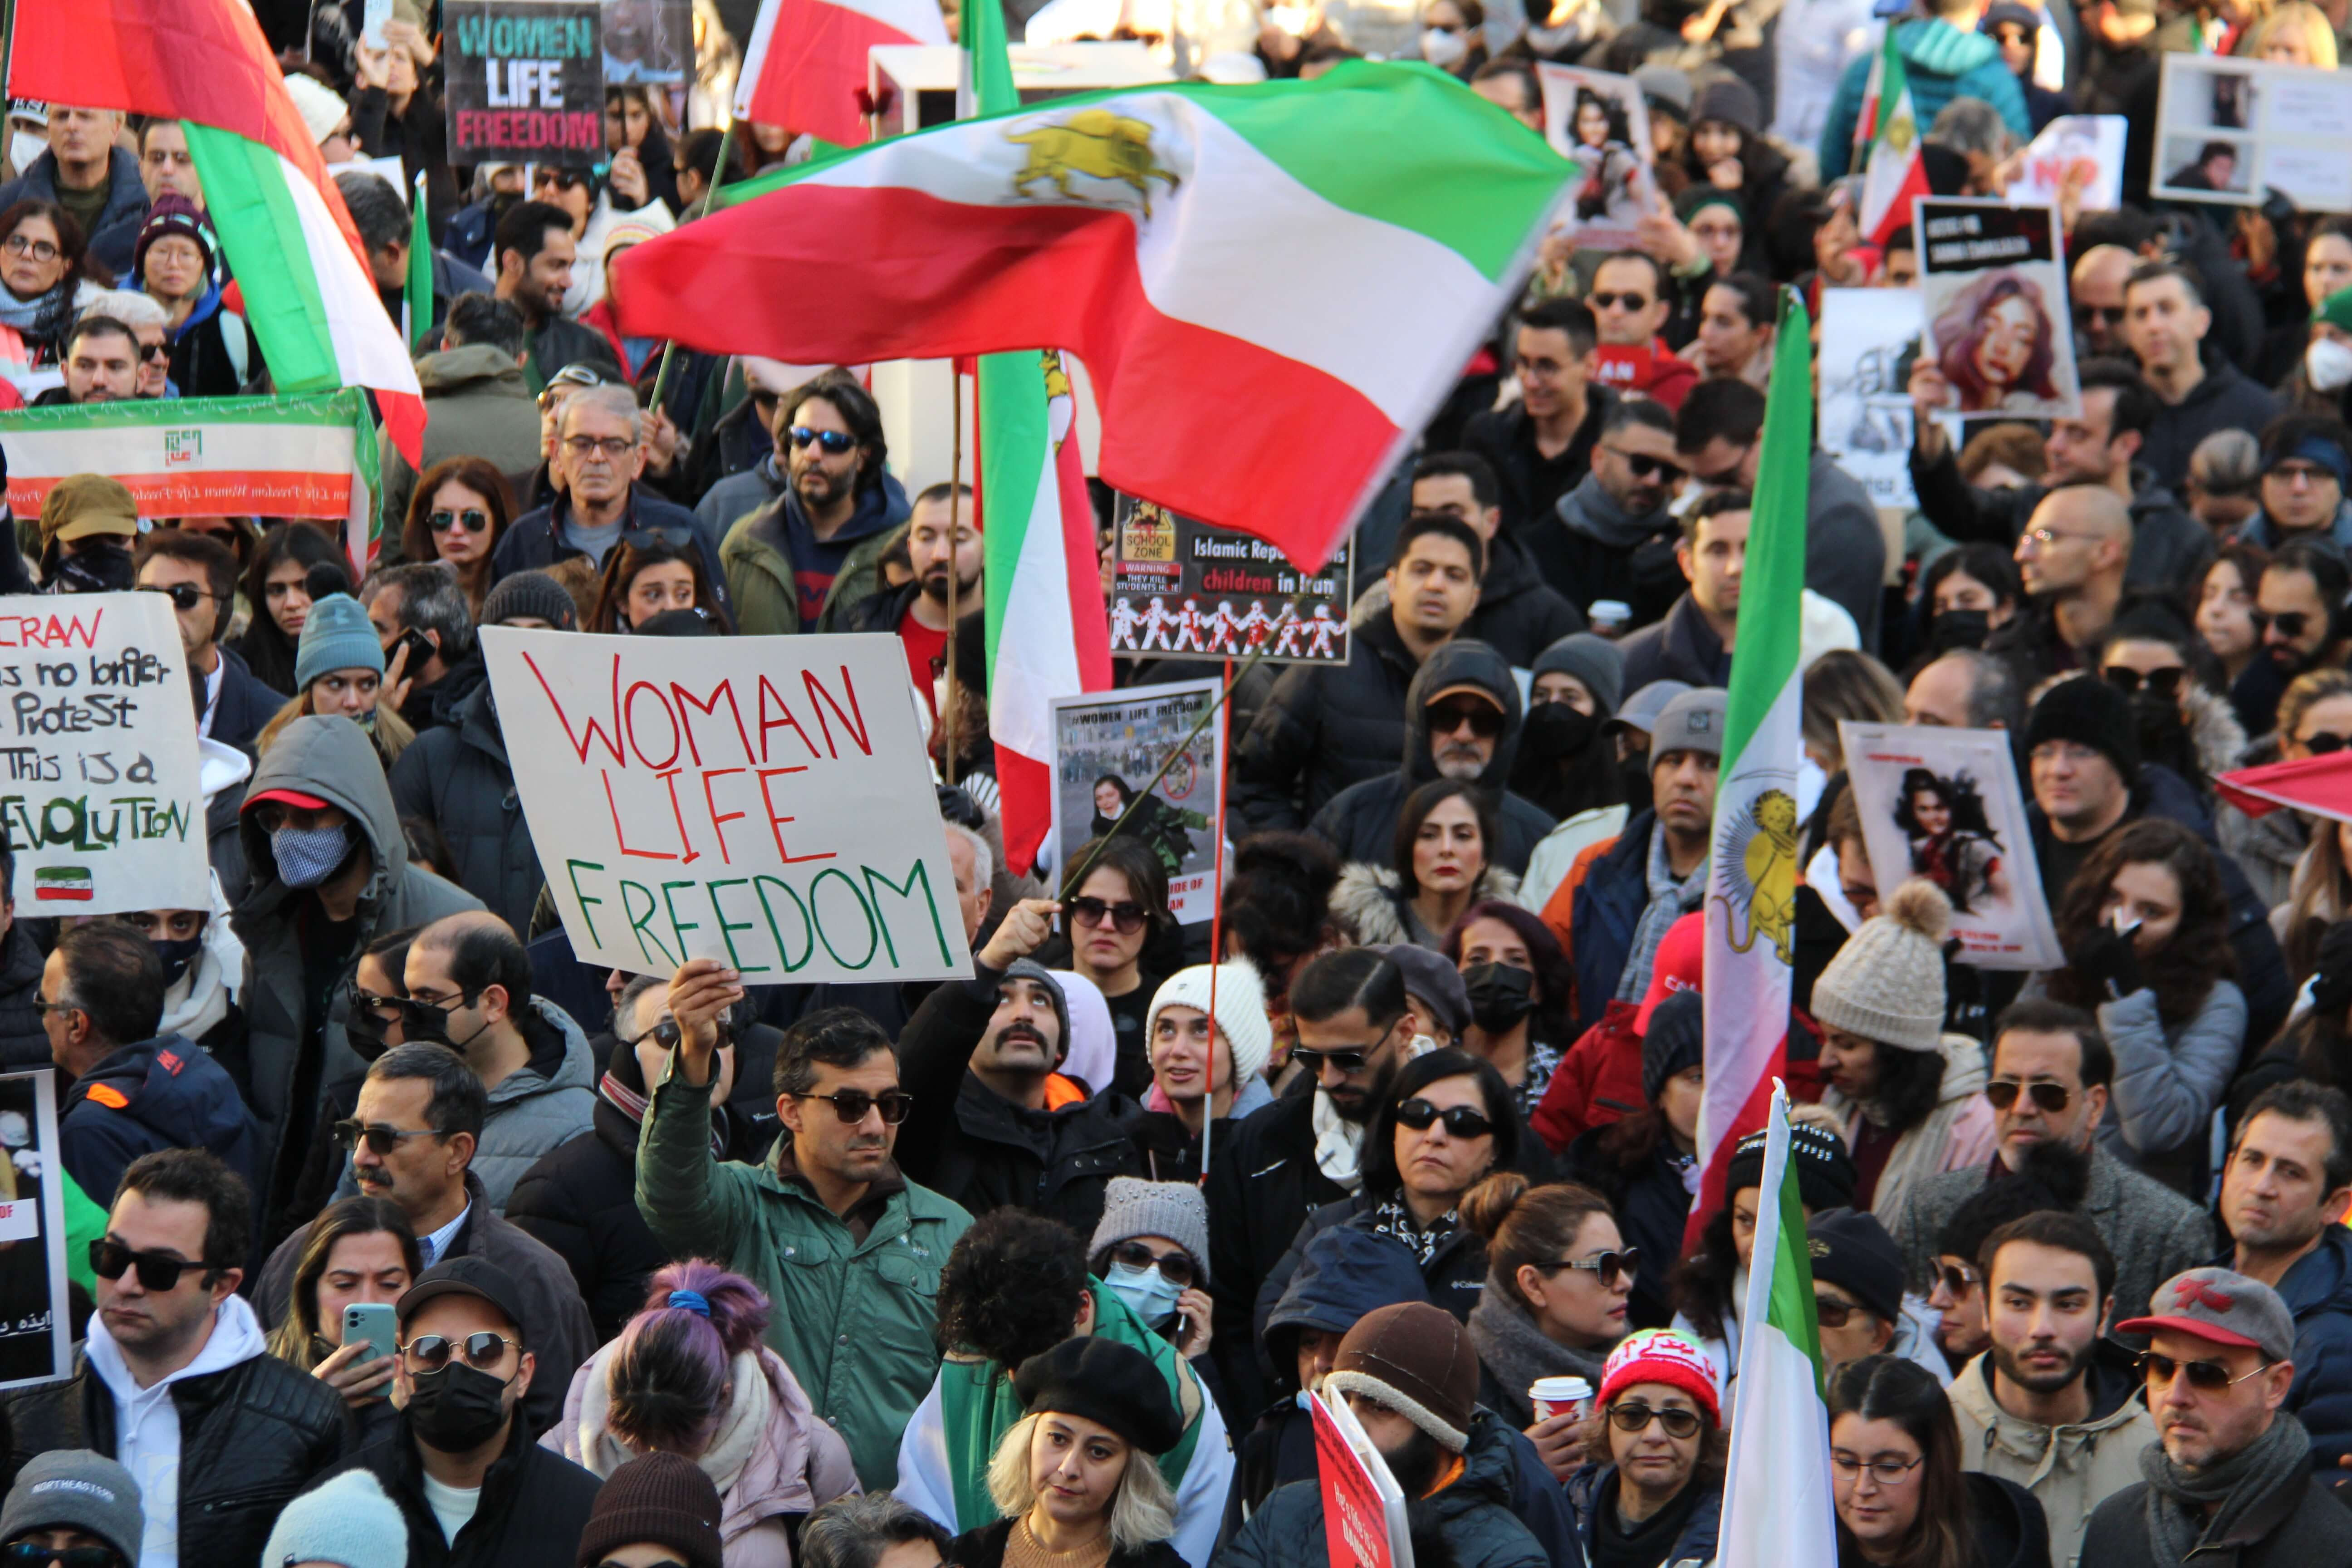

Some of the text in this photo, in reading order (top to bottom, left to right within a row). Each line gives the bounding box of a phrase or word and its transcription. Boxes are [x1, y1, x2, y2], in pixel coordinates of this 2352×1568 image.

[457, 16, 592, 59] WOMEN
[486, 59, 564, 108] LIFE
[456, 109, 599, 149] FREEDOM
[1127, 535, 1171, 547] SCHOOL
[1133, 546, 1162, 558] ZONE
[1195, 537, 1248, 559] Islamic
[1125, 564, 1169, 573] WARNING
[1127, 574, 1166, 583] THEY KILL
[1203, 567, 1335, 595] children in Iran
[1116, 582, 1156, 591] STUDENTS
[37, 661, 77, 686] no
[522, 651, 872, 770] WOMAN
[1072, 700, 1203, 725] #WOMEN LIFE FREEDOM
[127, 752, 157, 784] a
[0, 795, 191, 851] EVOLUTION
[601, 766, 837, 865] LIFE
[1191, 878, 1203, 890] OF
[567, 858, 953, 973] FREEDOM
[1169, 898, 1184, 911] AN
[31, 1480, 114, 1503] NORTHEASTERN
